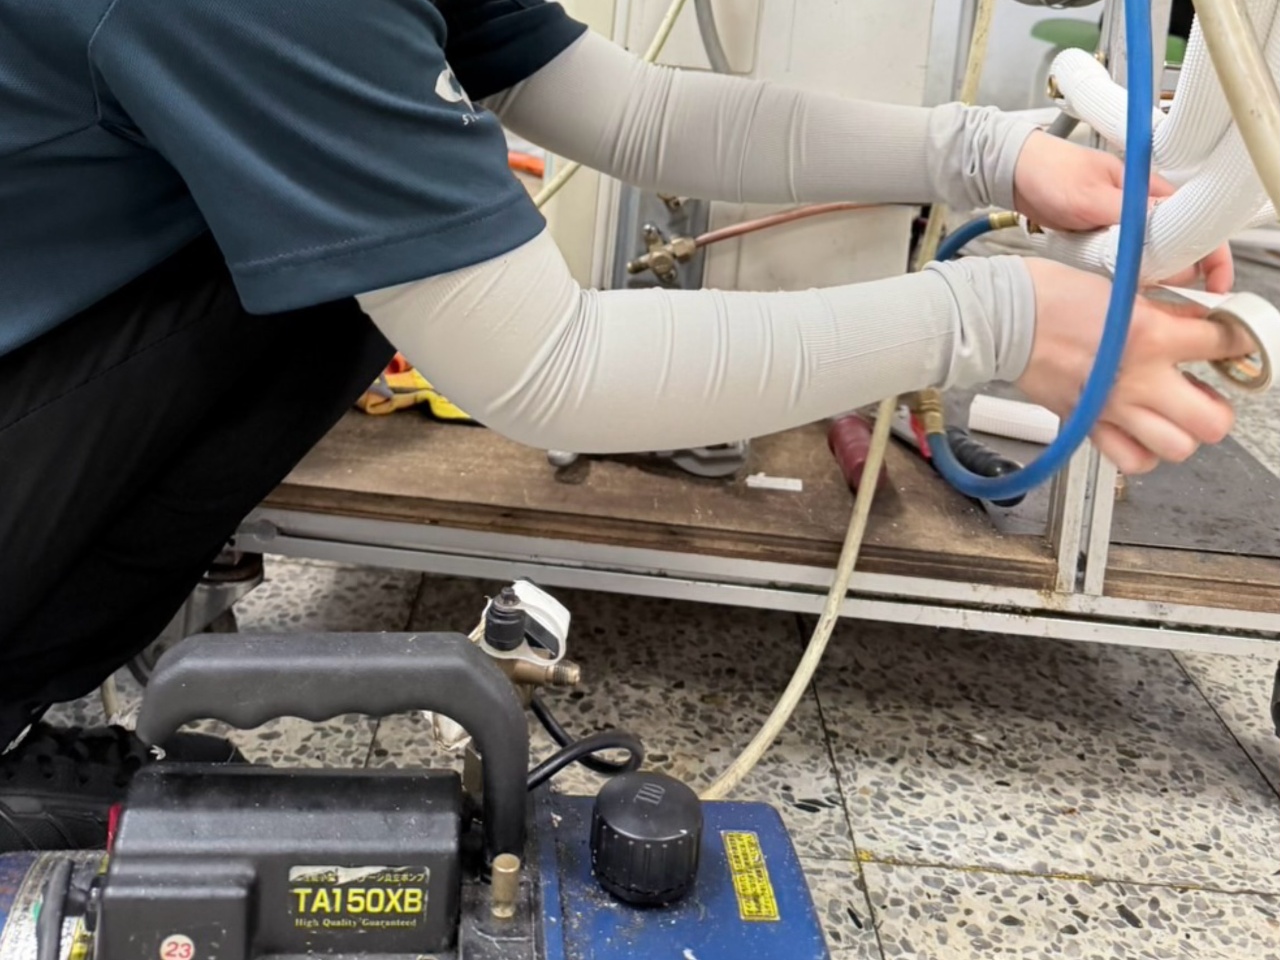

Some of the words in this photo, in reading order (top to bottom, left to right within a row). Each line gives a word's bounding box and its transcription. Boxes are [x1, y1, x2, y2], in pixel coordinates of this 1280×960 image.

[293, 887, 422, 913] TA150XB
[295, 918, 319, 928] High
[322, 918, 357, 928] Quality
[361, 918, 417, 929] Guaranteed
[165, 941, 192, 959] 23
